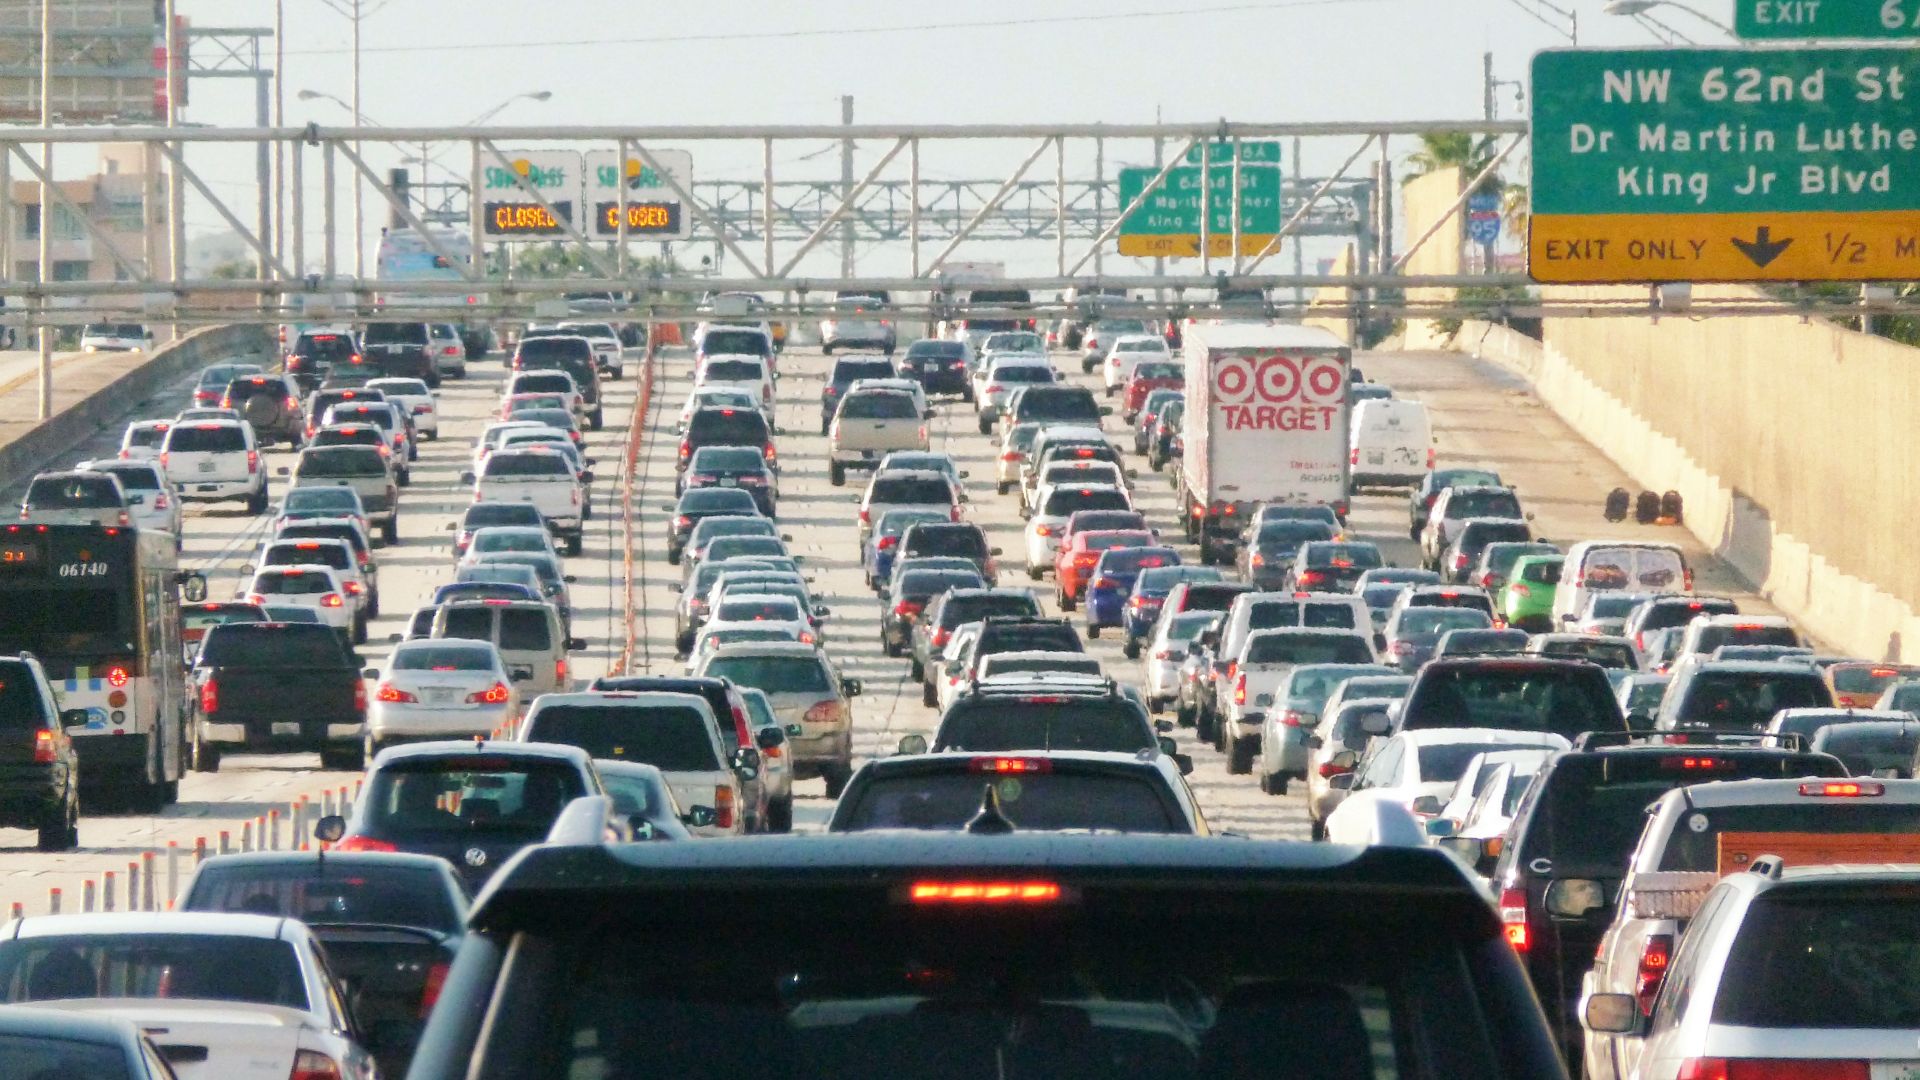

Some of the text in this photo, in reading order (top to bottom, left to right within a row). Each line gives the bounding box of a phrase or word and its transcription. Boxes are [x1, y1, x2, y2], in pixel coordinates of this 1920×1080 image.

[1755, 0, 1920, 28] EXIT 6
[1603, 67, 1904, 103] NW 62nd St
[1571, 122, 1918, 153] Dr Martin Luthe
[1618, 164, 1891, 204] King Jr Blvd
[607, 206, 668, 227] COSED
[1471, 220, 1497, 238] 95
[1546, 239, 1610, 261] EXIT
[1628, 238, 1707, 261] ONLY
[1824, 231, 1868, 264] 1/2
[1221, 406, 1337, 431] TARGET
[59, 562, 108, 577] 06740
